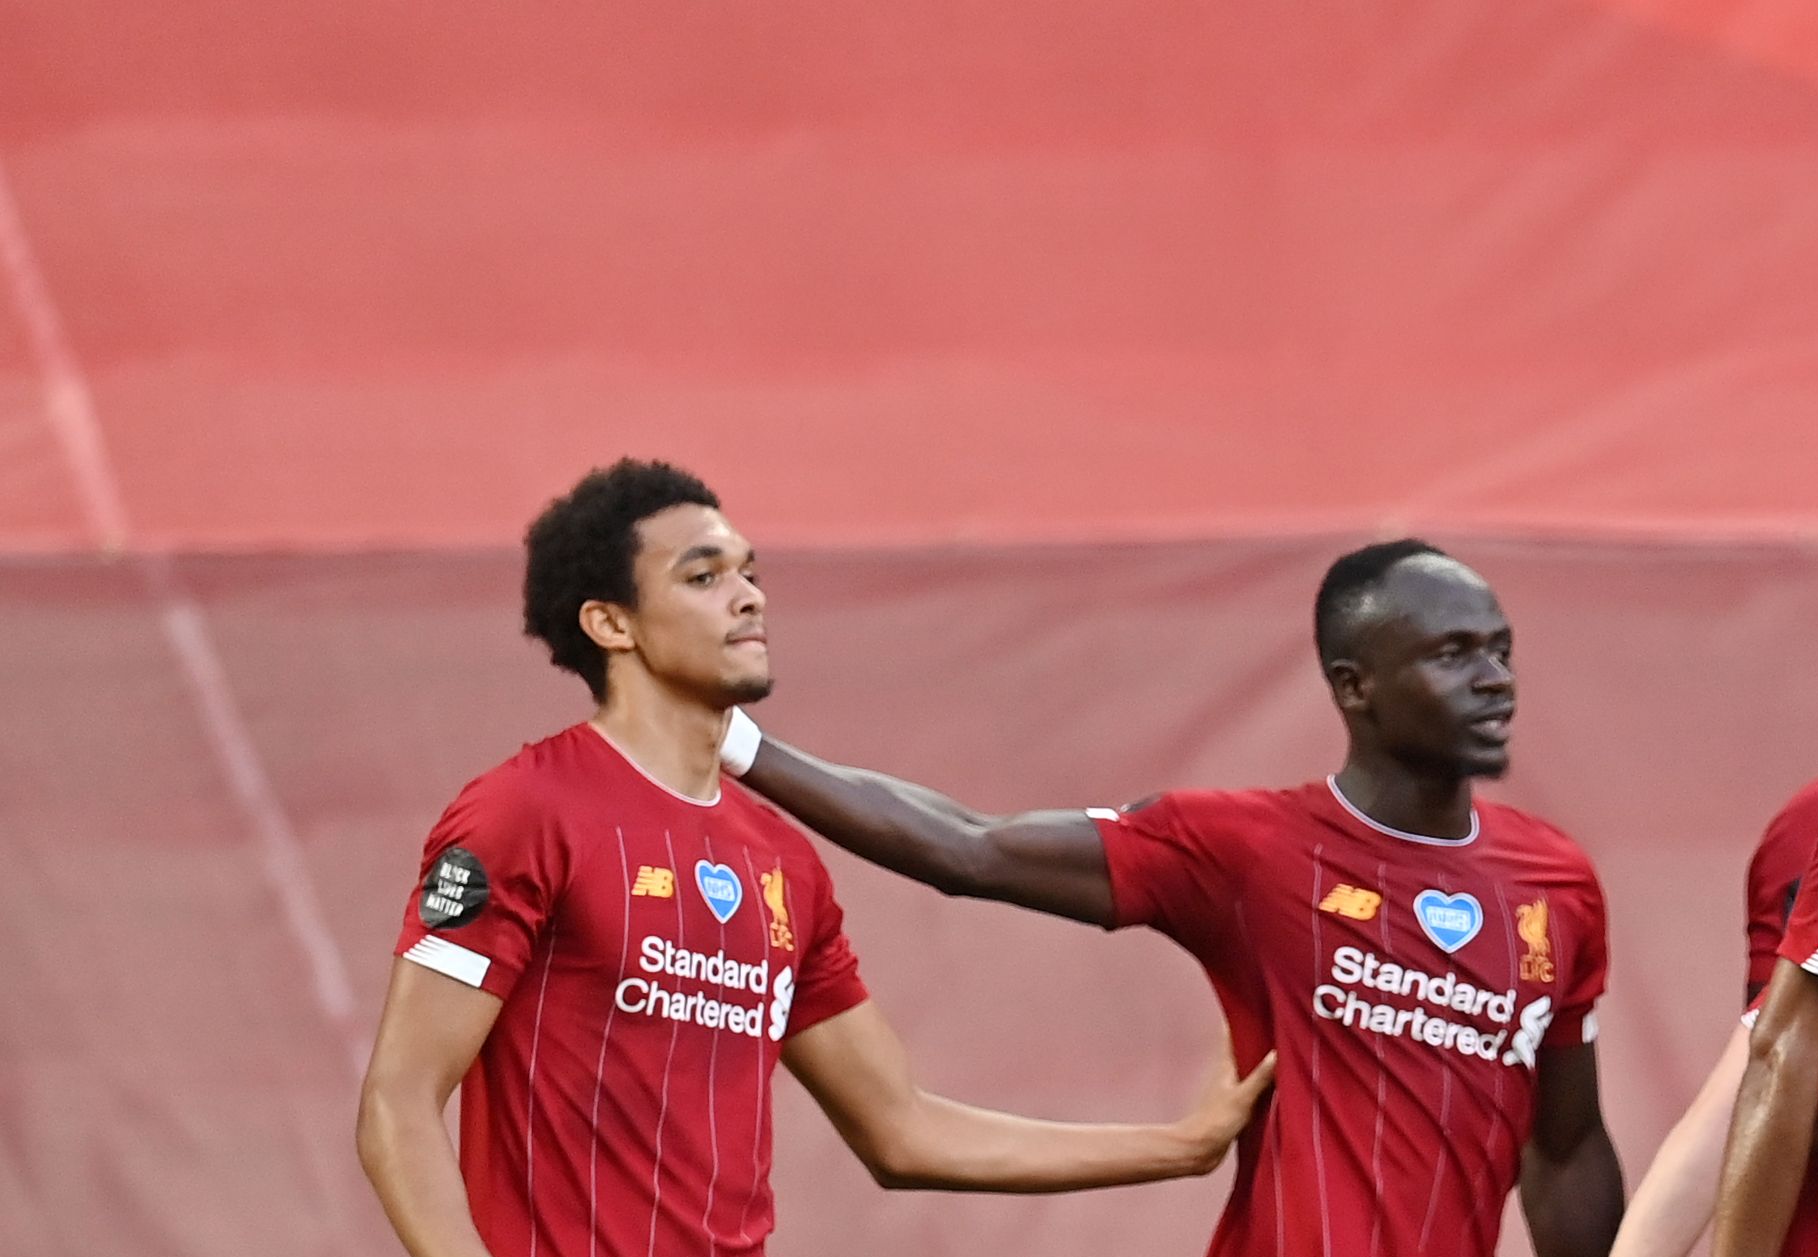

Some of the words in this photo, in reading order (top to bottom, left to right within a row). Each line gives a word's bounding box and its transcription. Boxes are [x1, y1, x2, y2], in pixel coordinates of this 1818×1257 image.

[639, 936, 768, 995] Standard
[1331, 946, 1517, 1024] Standard
[614, 977, 764, 1038] Chartered
[1312, 984, 1509, 1063] Chartered
